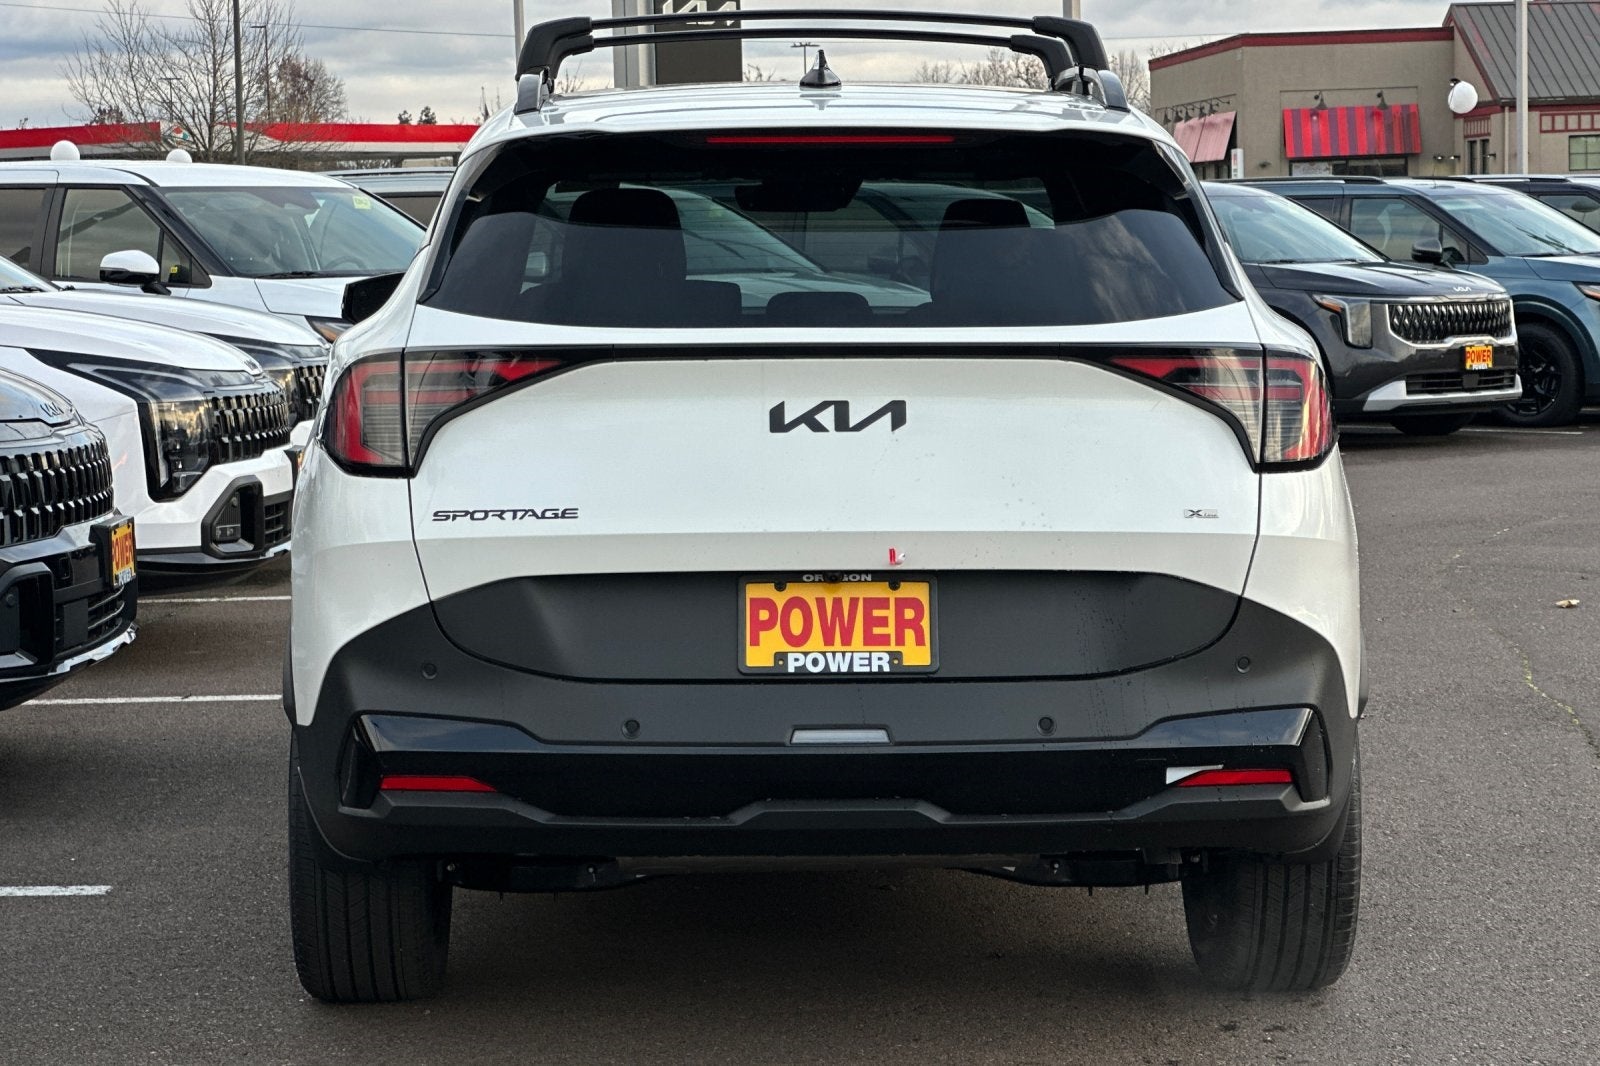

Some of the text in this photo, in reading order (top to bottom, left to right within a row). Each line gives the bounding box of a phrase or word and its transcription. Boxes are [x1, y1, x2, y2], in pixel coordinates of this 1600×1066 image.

[1466, 349, 1492, 363] POWER
[769, 400, 907, 433] KIA
[432, 507, 579, 522] SPORTAGE
[802, 573, 872, 582] ORON
[749, 596, 926, 647] POWER
[787, 652, 890, 673] POWER
